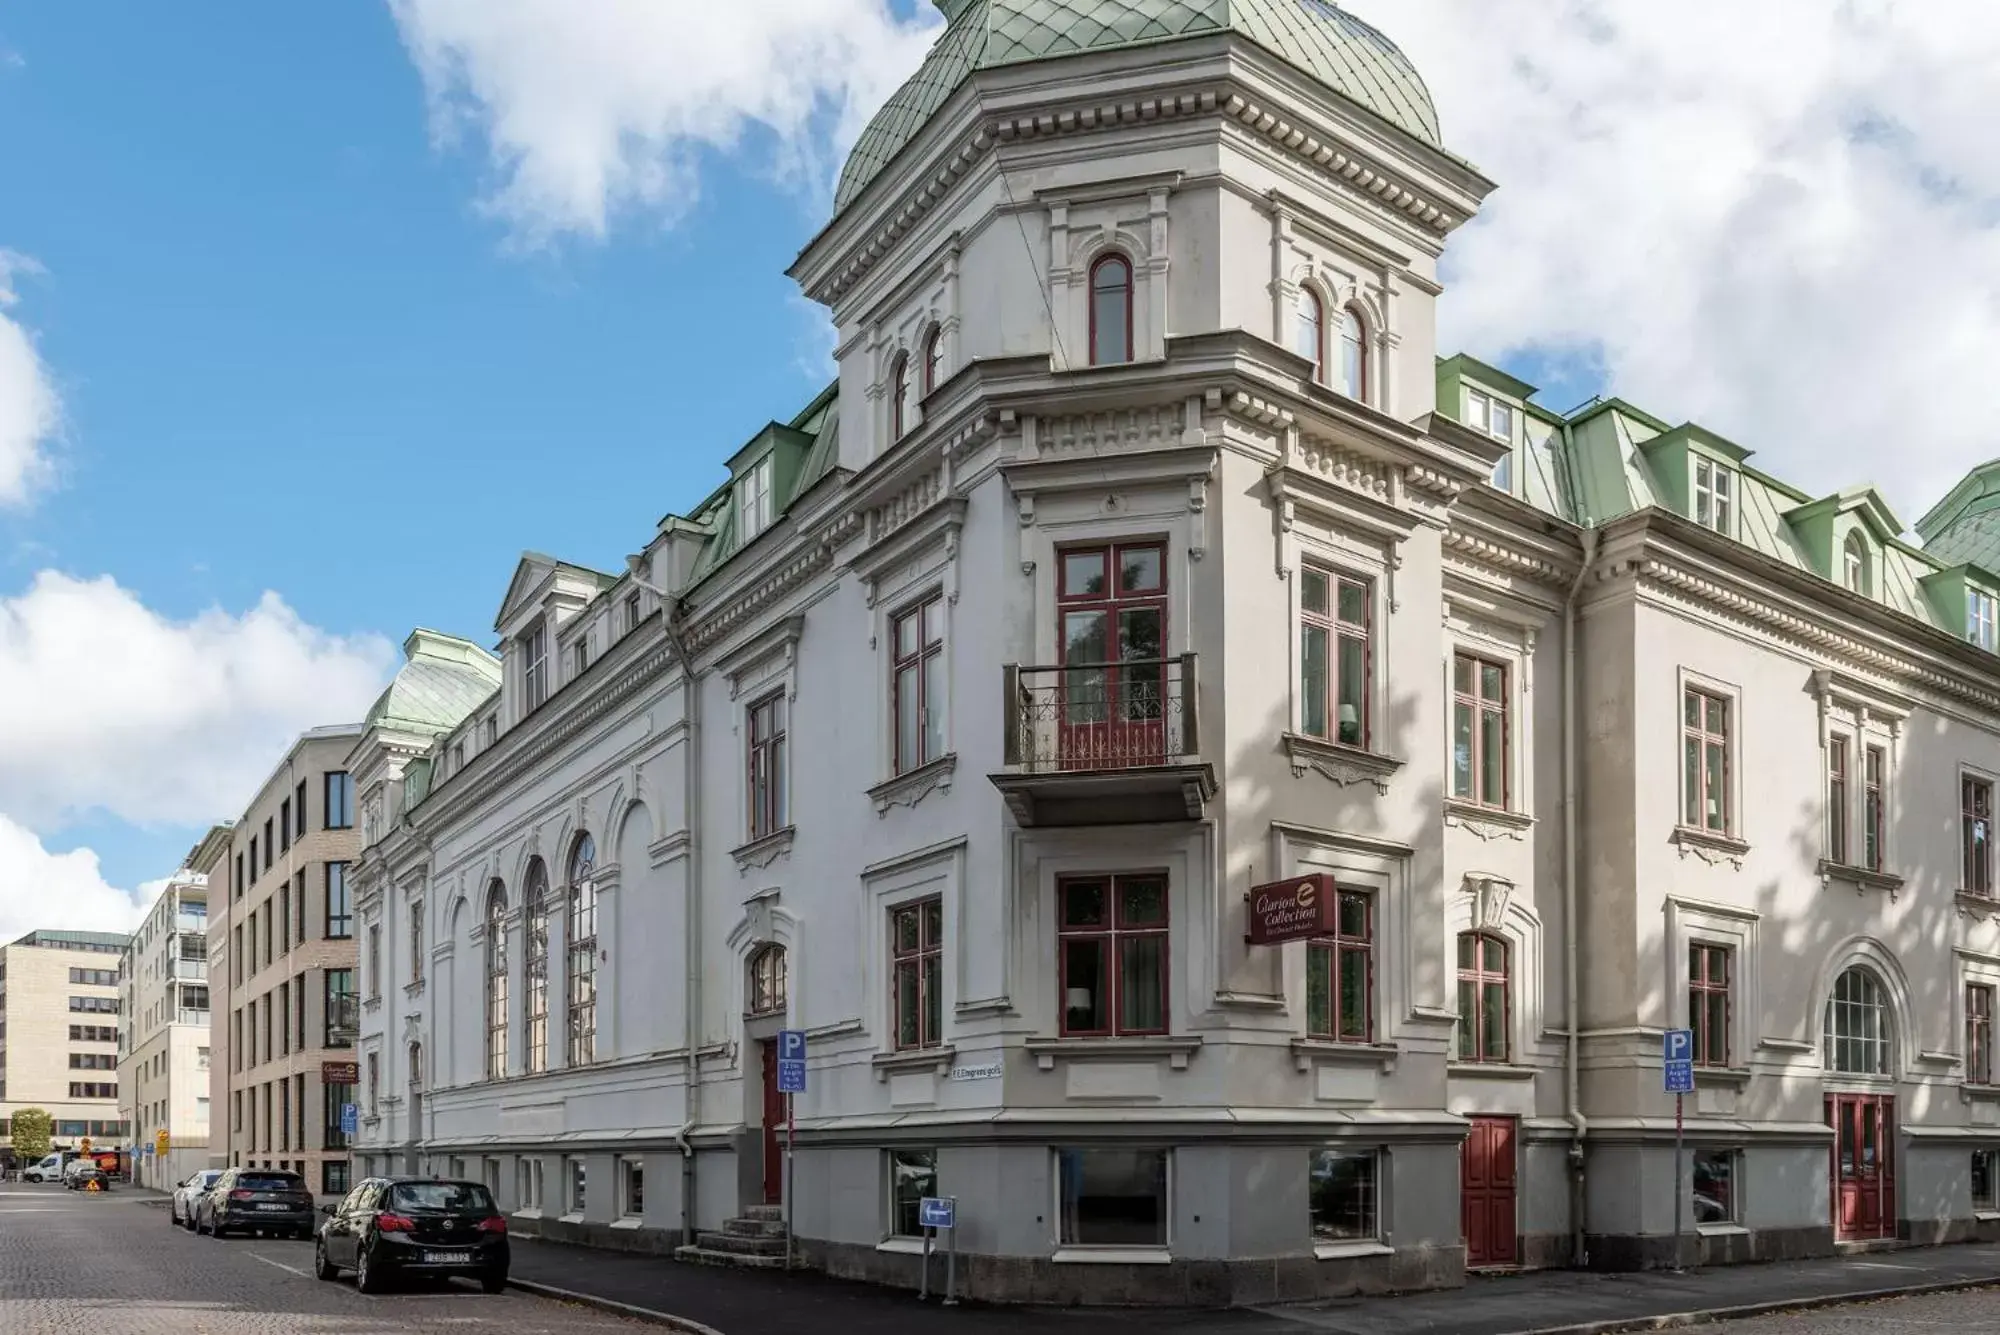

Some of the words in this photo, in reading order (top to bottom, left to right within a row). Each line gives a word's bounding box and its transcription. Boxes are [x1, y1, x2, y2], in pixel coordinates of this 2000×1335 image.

[1256, 894, 1296, 914] Clarion
[1265, 907, 1316, 926] Collection
[785, 1033, 801, 1058] P
[1671, 1033, 1687, 1059] P
